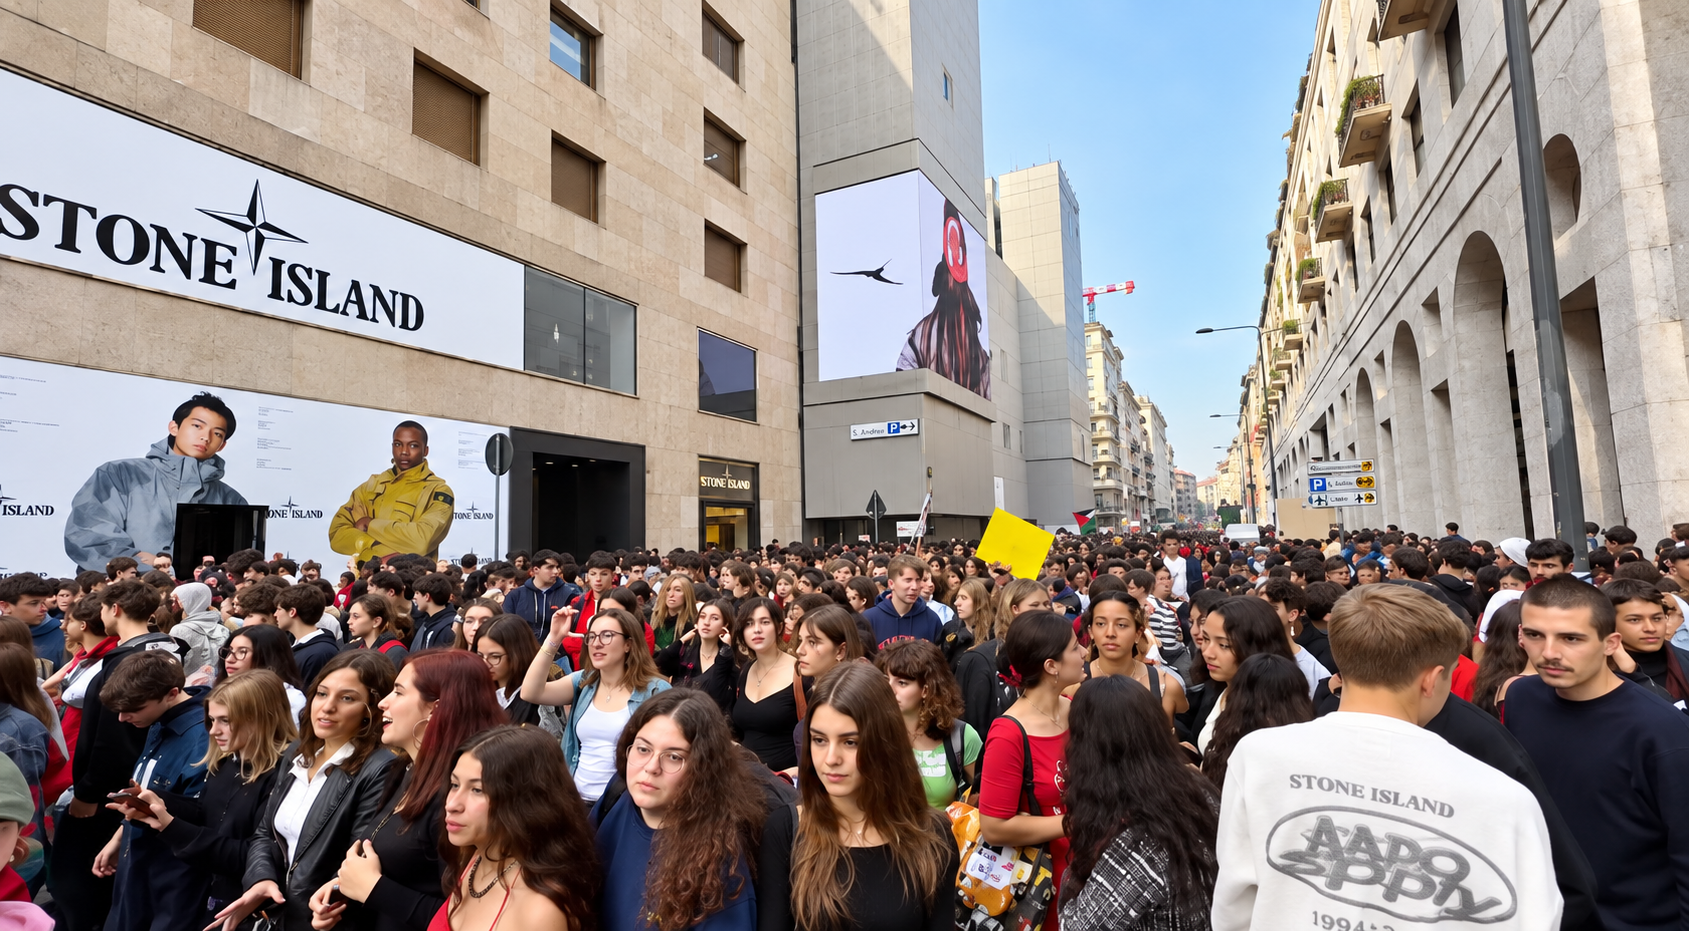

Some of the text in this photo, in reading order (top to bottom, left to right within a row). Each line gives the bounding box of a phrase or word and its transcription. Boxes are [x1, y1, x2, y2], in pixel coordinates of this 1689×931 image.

[0, 183, 425, 332] STONE ISLAND
[700, 476, 751, 490] STONE ISLAND
[2, 504, 55, 516] ISLAND
[266, 509, 323, 519] ONE ISLAND
[453, 512, 472, 520] TONE
[1289, 773, 1455, 819] STONE ISLAND
